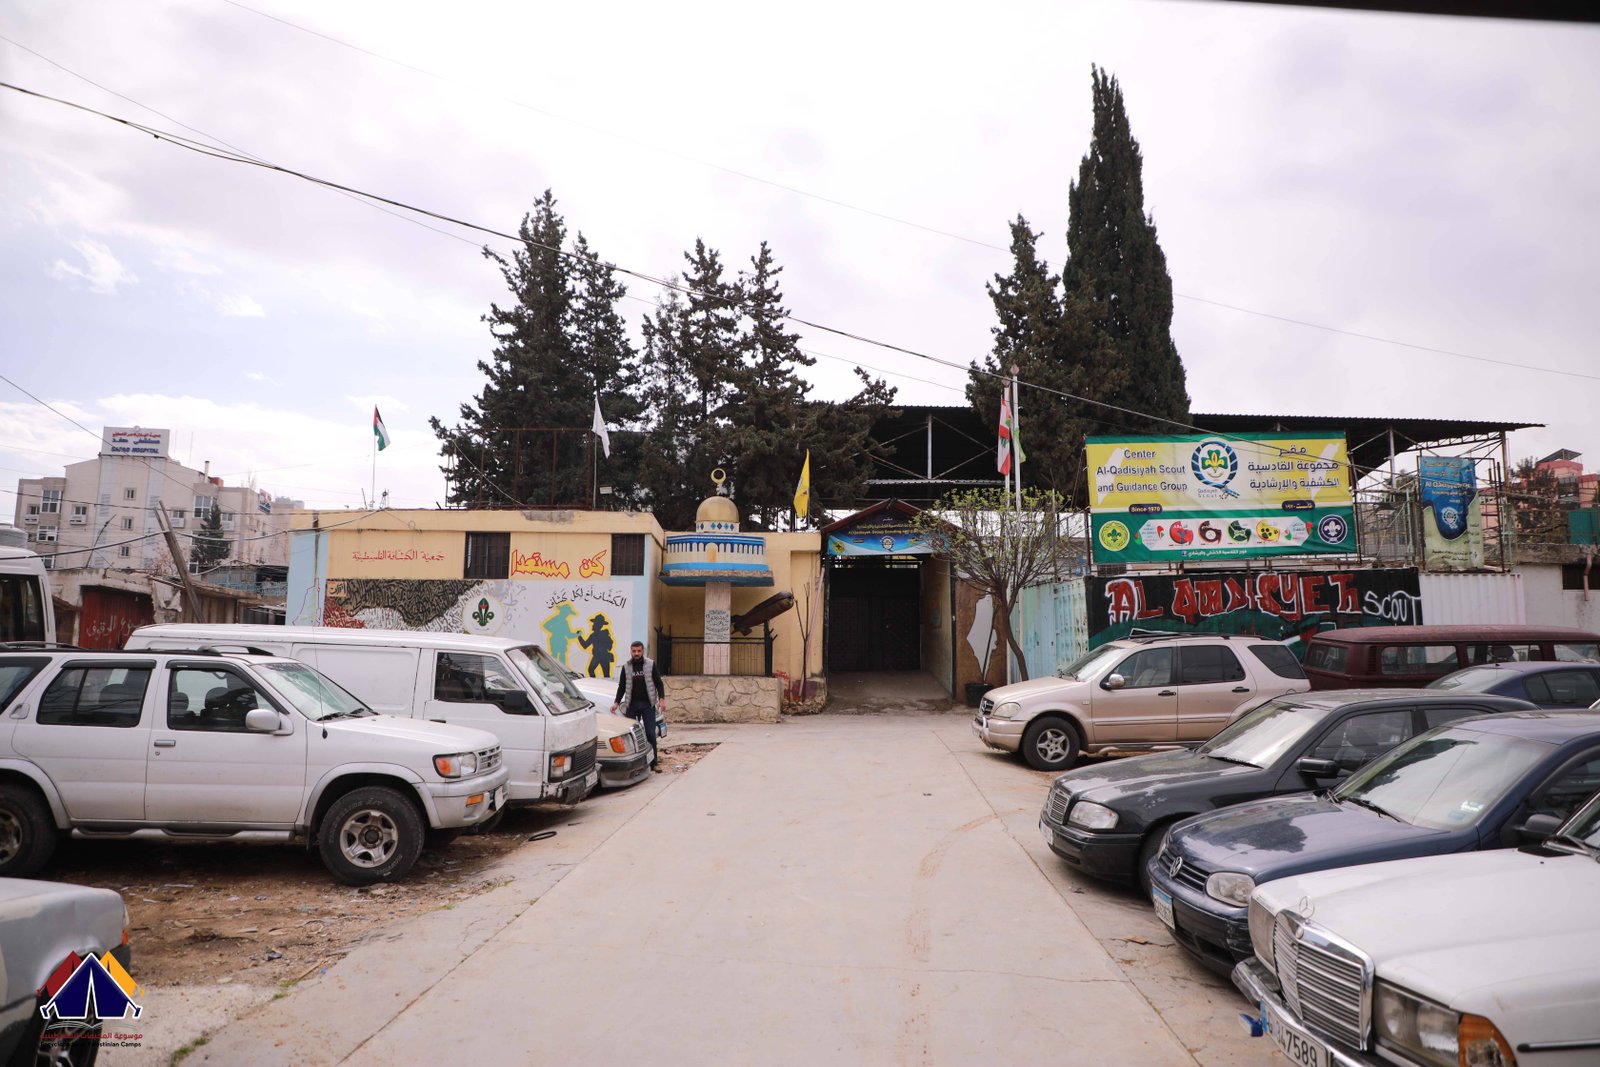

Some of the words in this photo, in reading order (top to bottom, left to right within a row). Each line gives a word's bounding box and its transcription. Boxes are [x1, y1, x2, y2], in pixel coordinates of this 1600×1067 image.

[1124, 449, 1155, 459] Center
[1279, 445, 1307, 457] مقر
[1096, 465, 1156, 476] Al-Qadisiyah
[1159, 464, 1186, 474] Scout
[1247, 461, 1294, 474] القادسية
[1296, 459, 1339, 473] مجموعة
[1097, 483, 1114, 492] and
[1116, 482, 1158, 492] Guidance
[1160, 481, 1188, 493] Group
[1299, 476, 1340, 490] الكشفية
[352, 550, 386, 562] الفلسطينية
[387, 548, 418, 562] الكشافة
[420, 550, 445, 563] جمعية
[579, 549, 607, 579] كن
[1104, 578, 1163, 626] AL
[1362, 590, 1421, 627] SCOUT
